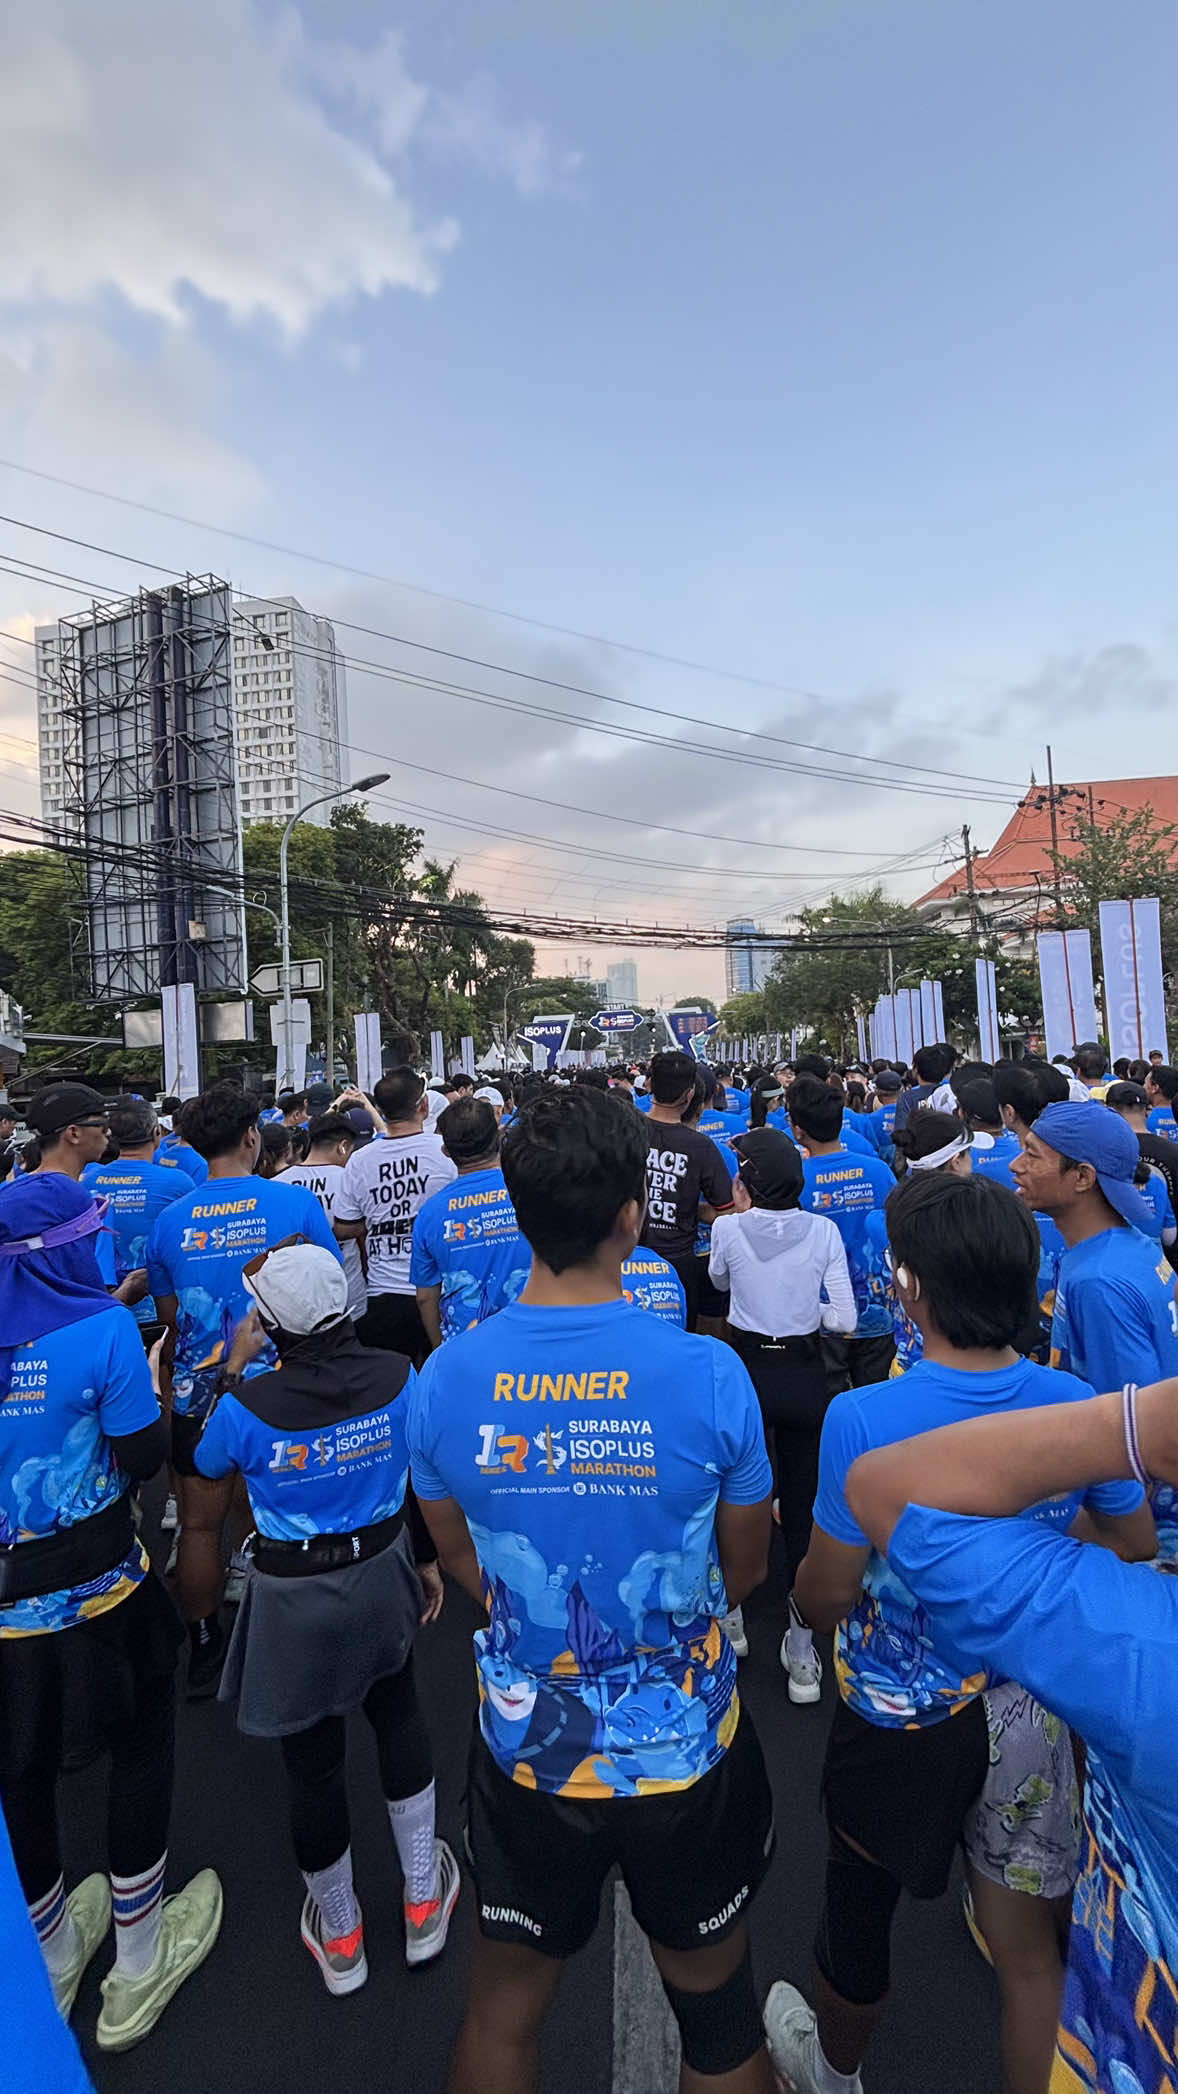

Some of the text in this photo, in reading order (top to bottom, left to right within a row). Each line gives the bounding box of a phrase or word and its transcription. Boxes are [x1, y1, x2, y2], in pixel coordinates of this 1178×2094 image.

[524, 1025, 562, 1036] ISOPLUS
[378, 1156, 418, 1180] RUN
[646, 1147, 688, 1177] ACE
[96, 1175, 142, 1184] RUNNER
[816, 1167, 864, 1183] RUNNER
[368, 1174, 430, 1205] TODAY
[844, 1189, 874, 1200] ISOPLUS
[192, 1198, 257, 1218] RUNNER
[390, 1199, 411, 1217] OR
[448, 1189, 508, 1212] RUNNER
[227, 1217, 267, 1228] SURABAYA
[482, 1215, 518, 1230] ISOPLUS
[227, 1226, 267, 1240] ISOPLUS
[621, 1261, 671, 1274] UNNER
[10, 1360, 49, 1372] ABAYA
[10, 1374, 48, 1387] PLUS
[494, 1371, 630, 1401] RUNNER
[0, 1405, 46, 1416] ANK MAS
[335, 1413, 390, 1435] SURABAYA
[568, 1419, 653, 1434] SURABAYA
[336, 1425, 392, 1452] ISOPLUS
[569, 1439, 656, 1459] ISOPLUS
[570, 1462, 657, 1477] MARATHON
[590, 1483, 626, 1495] BANK
[629, 1485, 659, 1495] MAS
[698, 1885, 749, 1935] SQUADS
[482, 1904, 543, 1937] RUNNING
